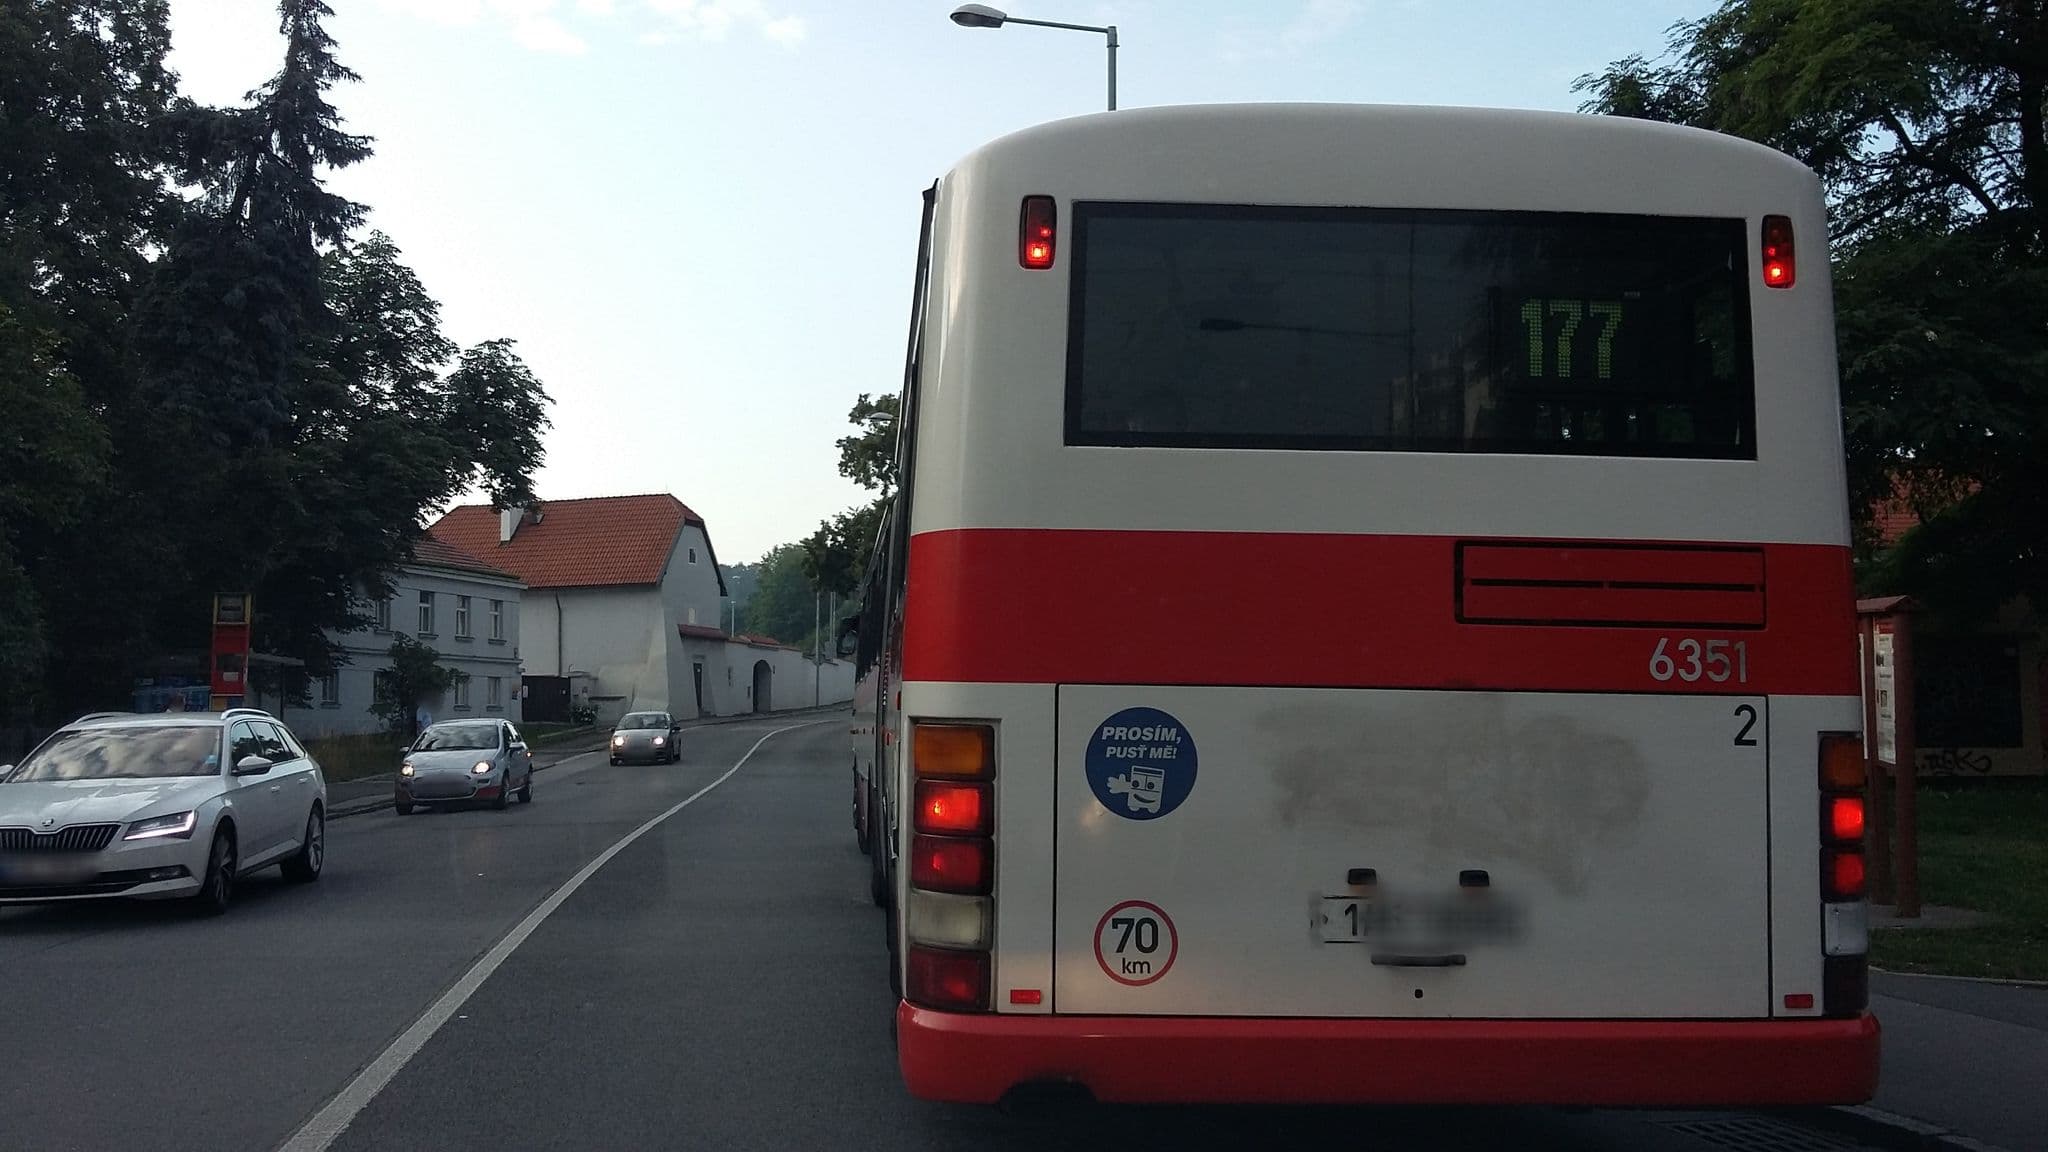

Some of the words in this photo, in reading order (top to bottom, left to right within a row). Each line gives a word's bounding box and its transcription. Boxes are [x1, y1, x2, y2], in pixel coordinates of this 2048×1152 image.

[1520, 299, 1622, 377] 177
[1649, 638, 1747, 683] 6351
[1101, 725, 1181, 744] PROSÍM,
[1734, 704, 1757, 747] 2
[1111, 917, 1159, 954] 70
[1122, 957, 1151, 974] km
